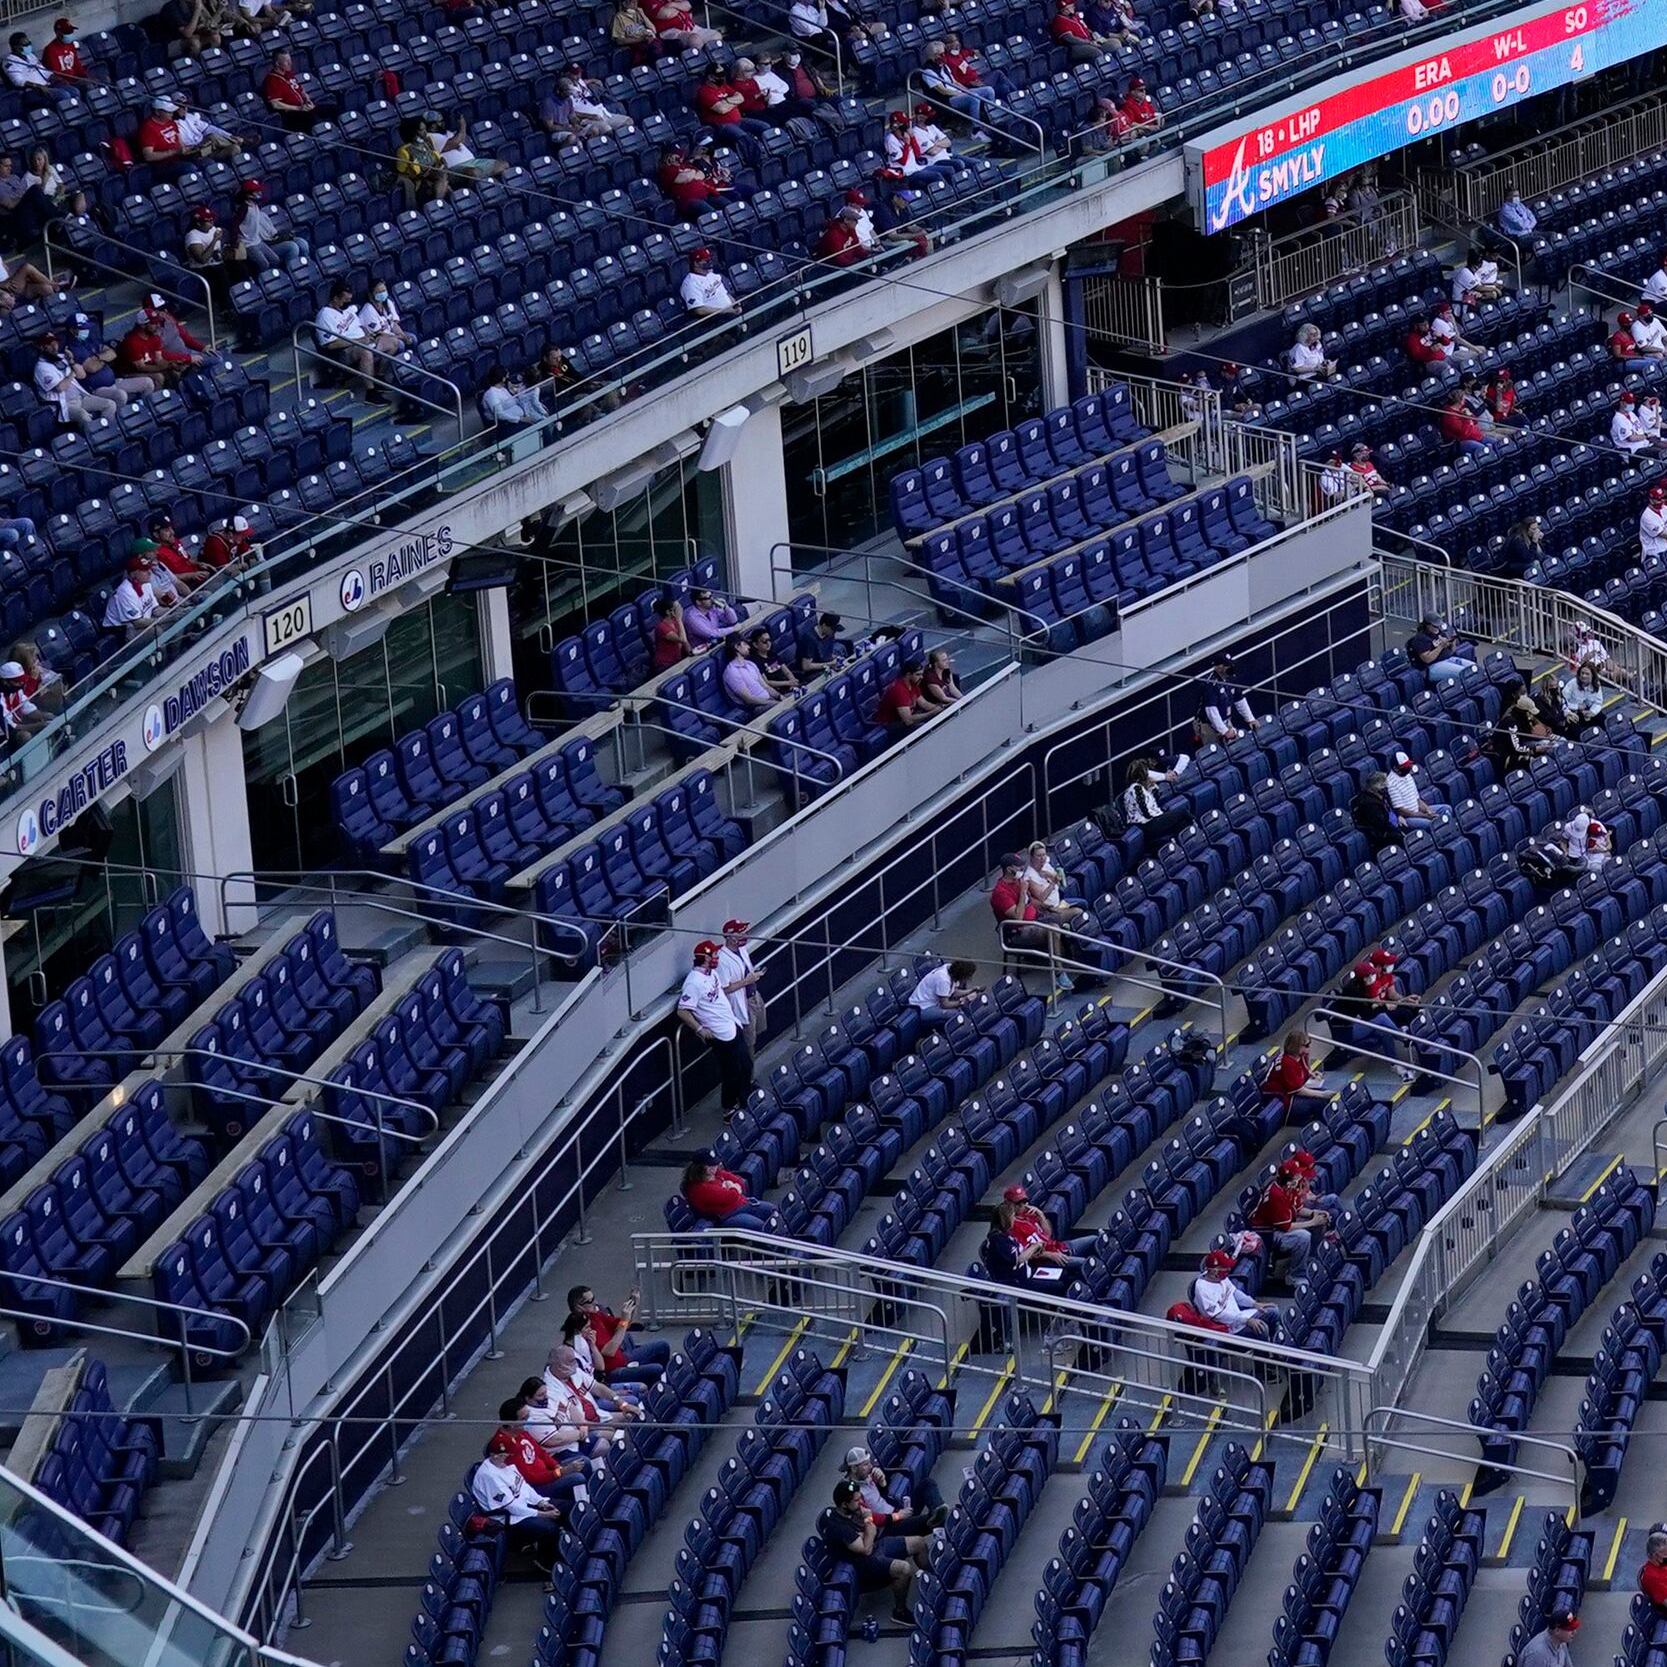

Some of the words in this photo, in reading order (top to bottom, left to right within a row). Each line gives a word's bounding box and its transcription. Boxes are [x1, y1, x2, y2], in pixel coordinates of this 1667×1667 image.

[1414, 57, 1453, 90] ERA
[1494, 31, 1527, 59] W-L
[1565, 8, 1588, 33] SO
[1407, 91, 1460, 135] 0.00
[1491, 64, 1531, 103] 0-0
[1570, 44, 1584, 73] 4
[1256, 128, 1275, 156] 18
[1288, 108, 1321, 142] LHP
[1259, 145, 1325, 202] SMYLY
[784, 337, 807, 369] 119
[369, 526, 453, 594] RAINES
[272, 605, 304, 646] 120
[163, 636, 250, 734] DAWSON
[39, 739, 128, 836] CARTER
